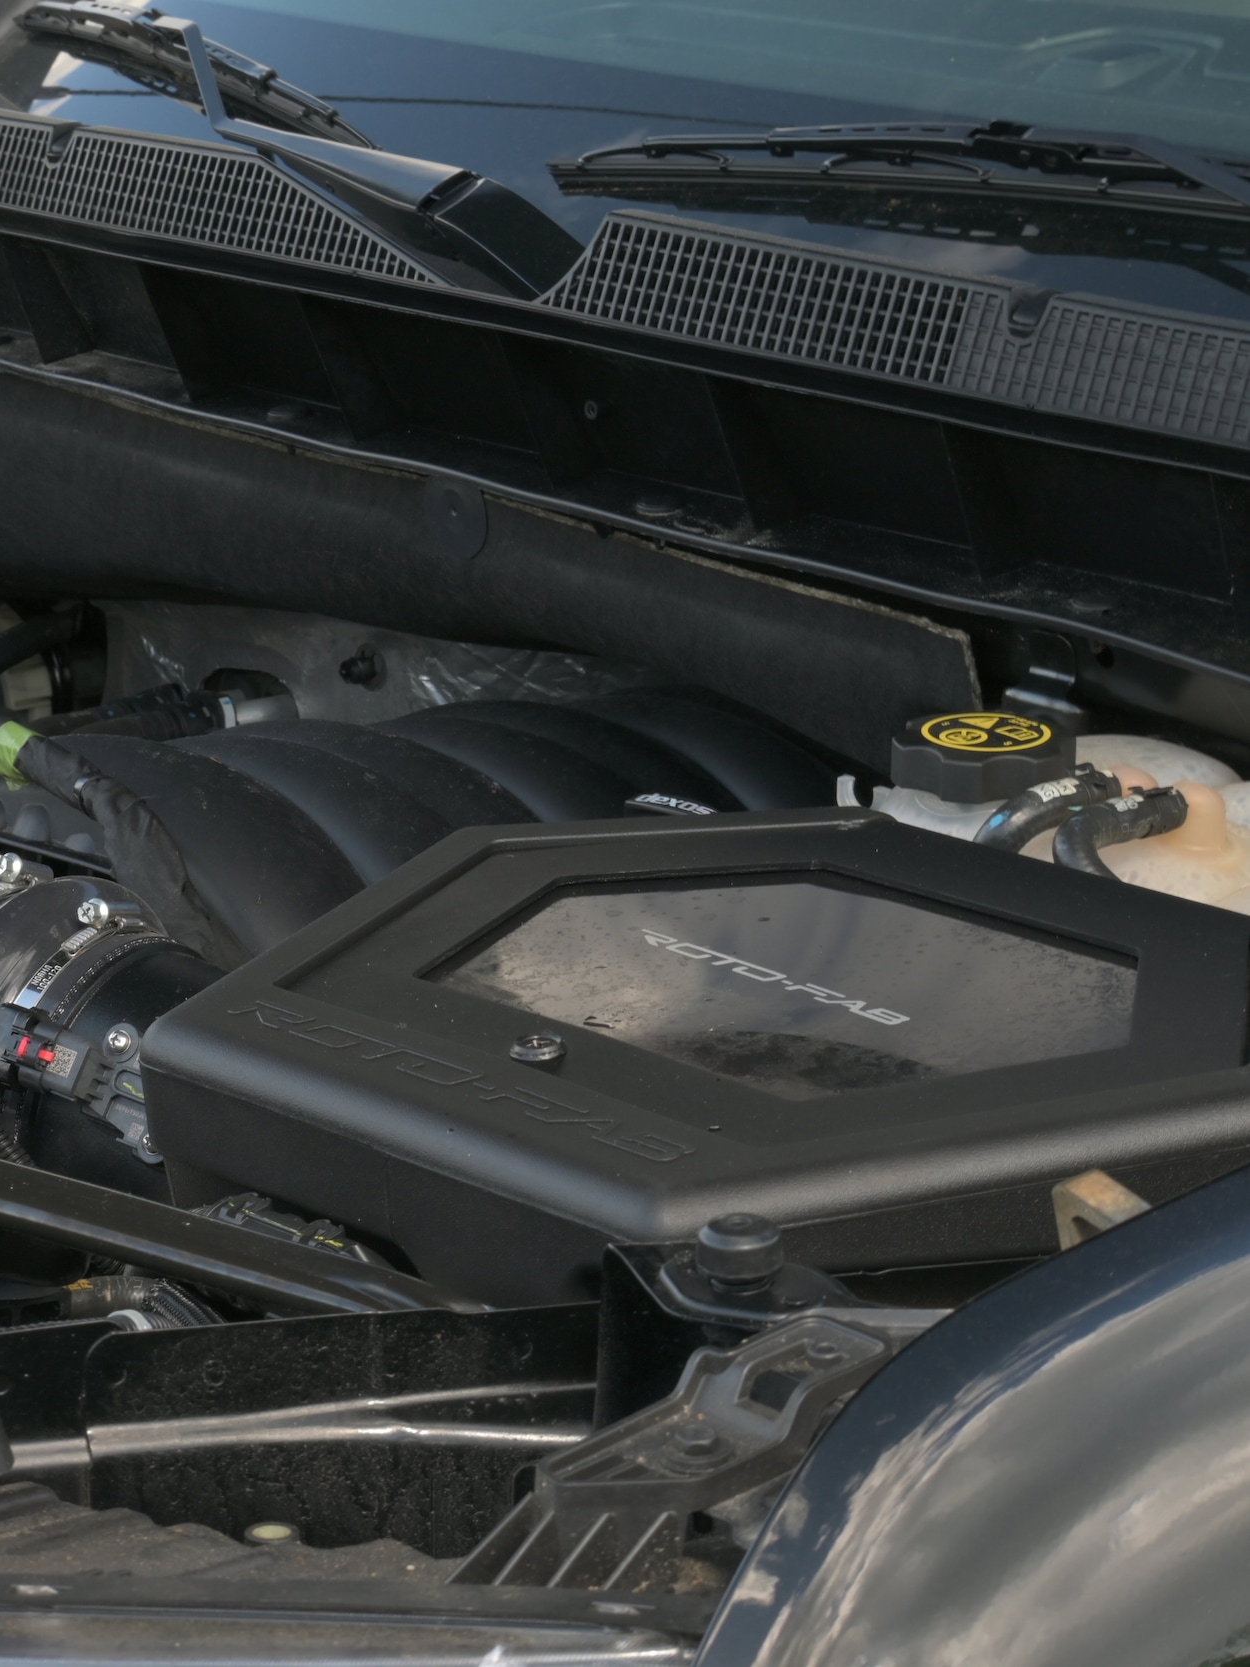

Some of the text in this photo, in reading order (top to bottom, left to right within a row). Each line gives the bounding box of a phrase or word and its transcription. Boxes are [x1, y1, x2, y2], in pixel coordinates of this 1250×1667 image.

[634, 792, 717, 815] dexos
[36, 964, 63, 992] 100-120
[641, 928, 911, 1026] ROTO-FAB
[226, 999, 697, 1163] ROTO-FAB
